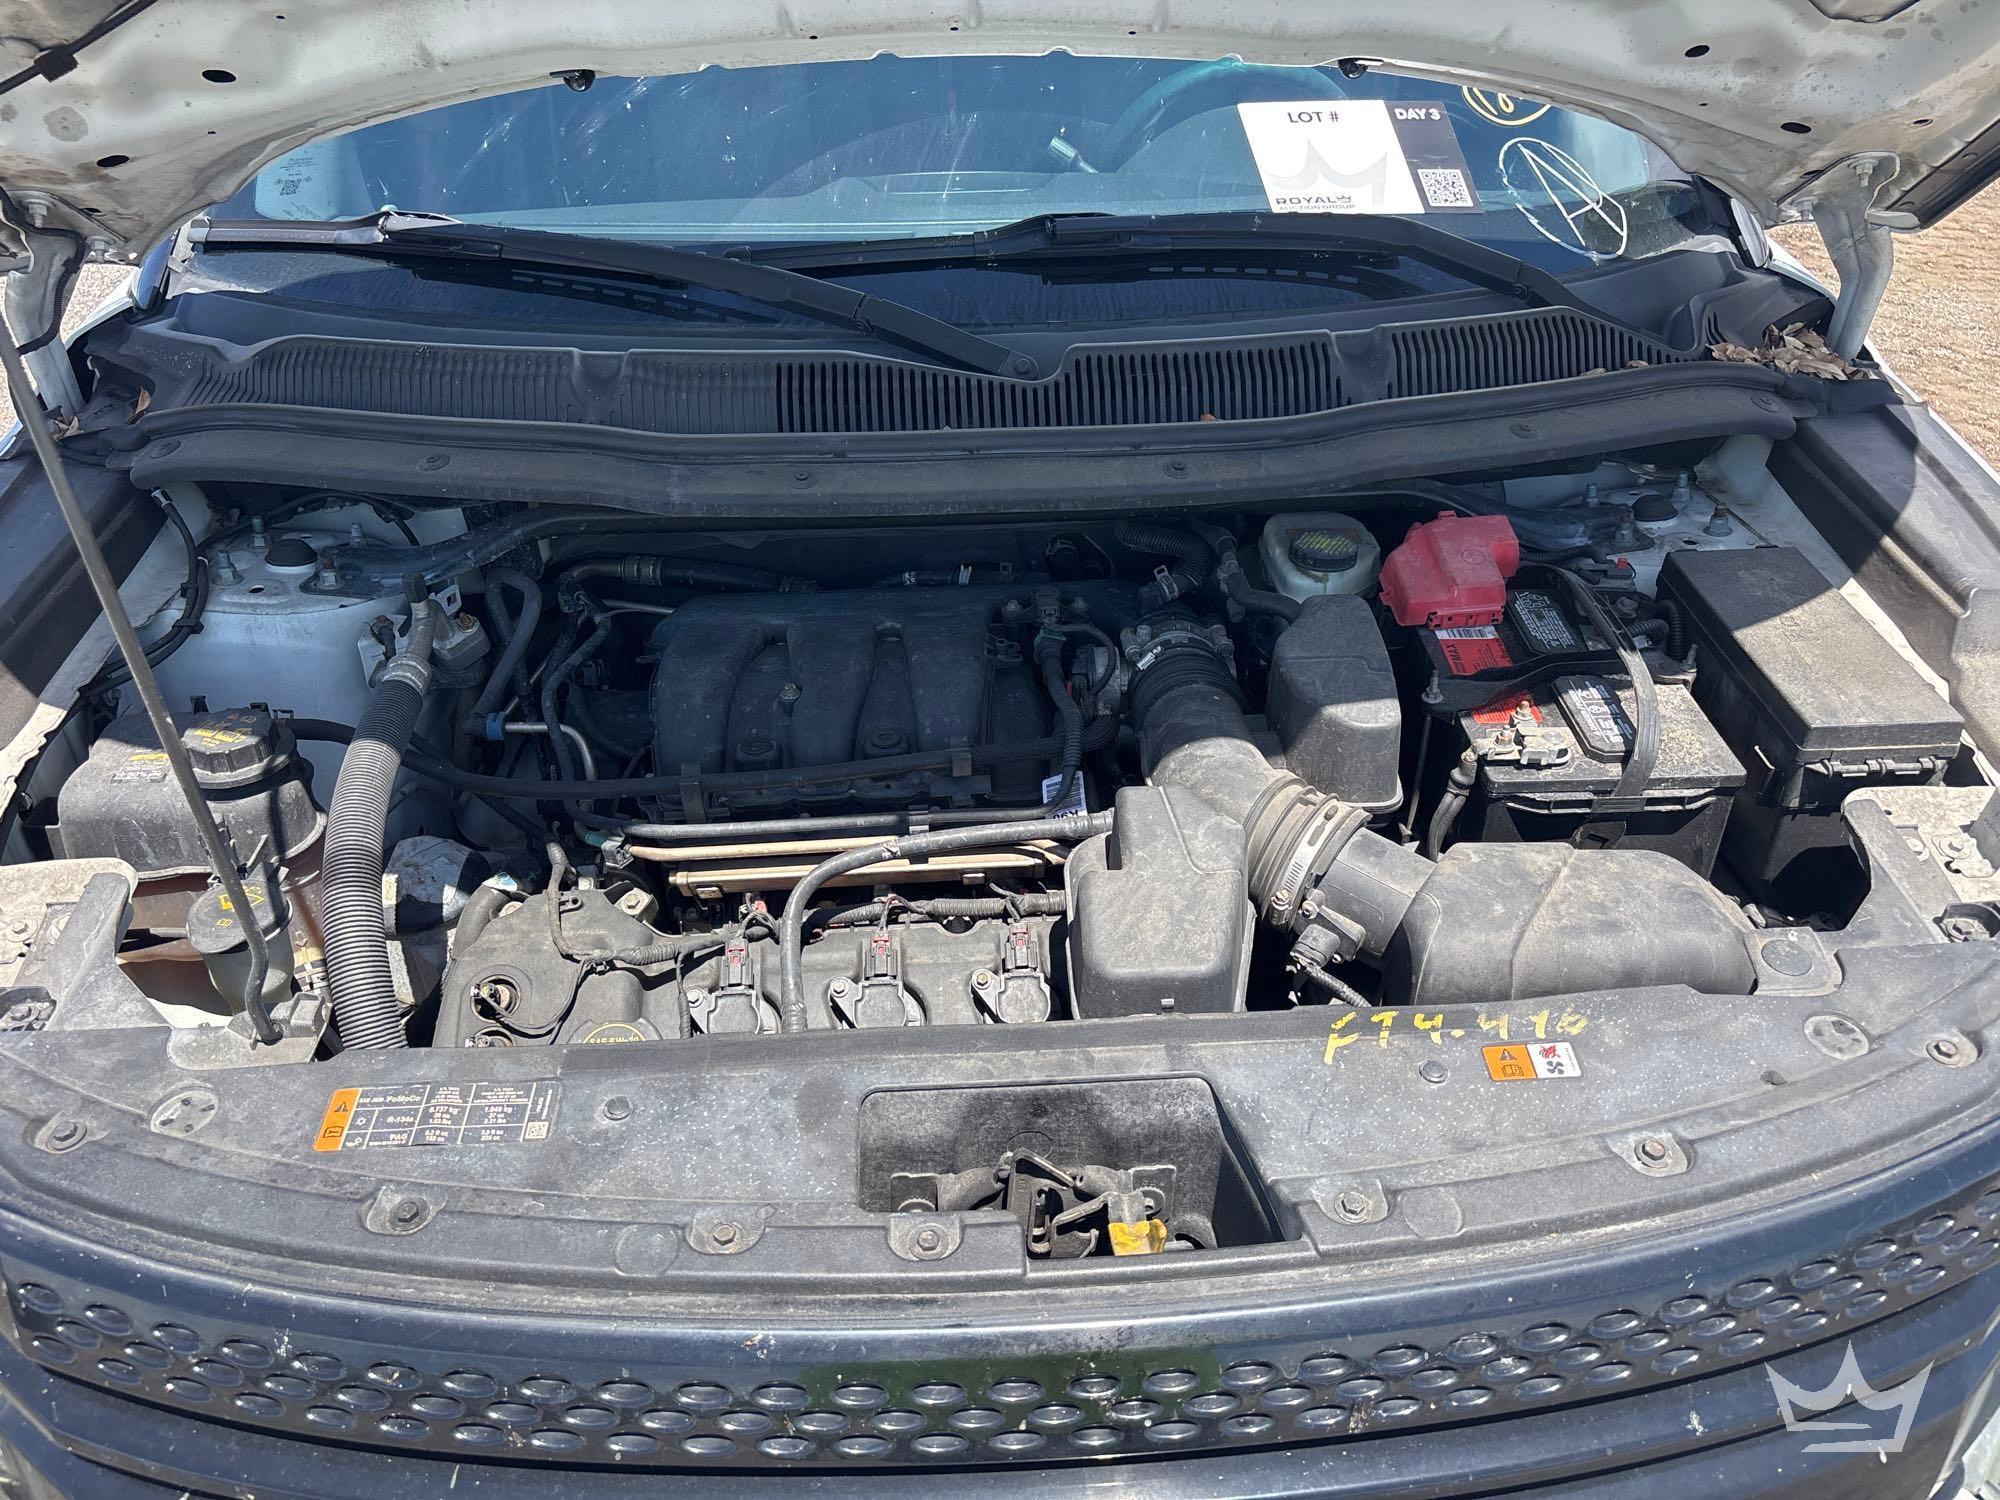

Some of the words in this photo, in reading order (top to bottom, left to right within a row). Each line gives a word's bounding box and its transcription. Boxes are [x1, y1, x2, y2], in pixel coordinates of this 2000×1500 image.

[1287, 111, 1323, 124] LOT
[1329, 111, 1340, 123] #
[1394, 107, 1427, 121] DAY
[1429, 108, 1441, 121] 3
[1275, 196, 1338, 205] ROYAL
[1446, 643, 1462, 661] MAX
[387, 1115, 414, 1123] R-134a
